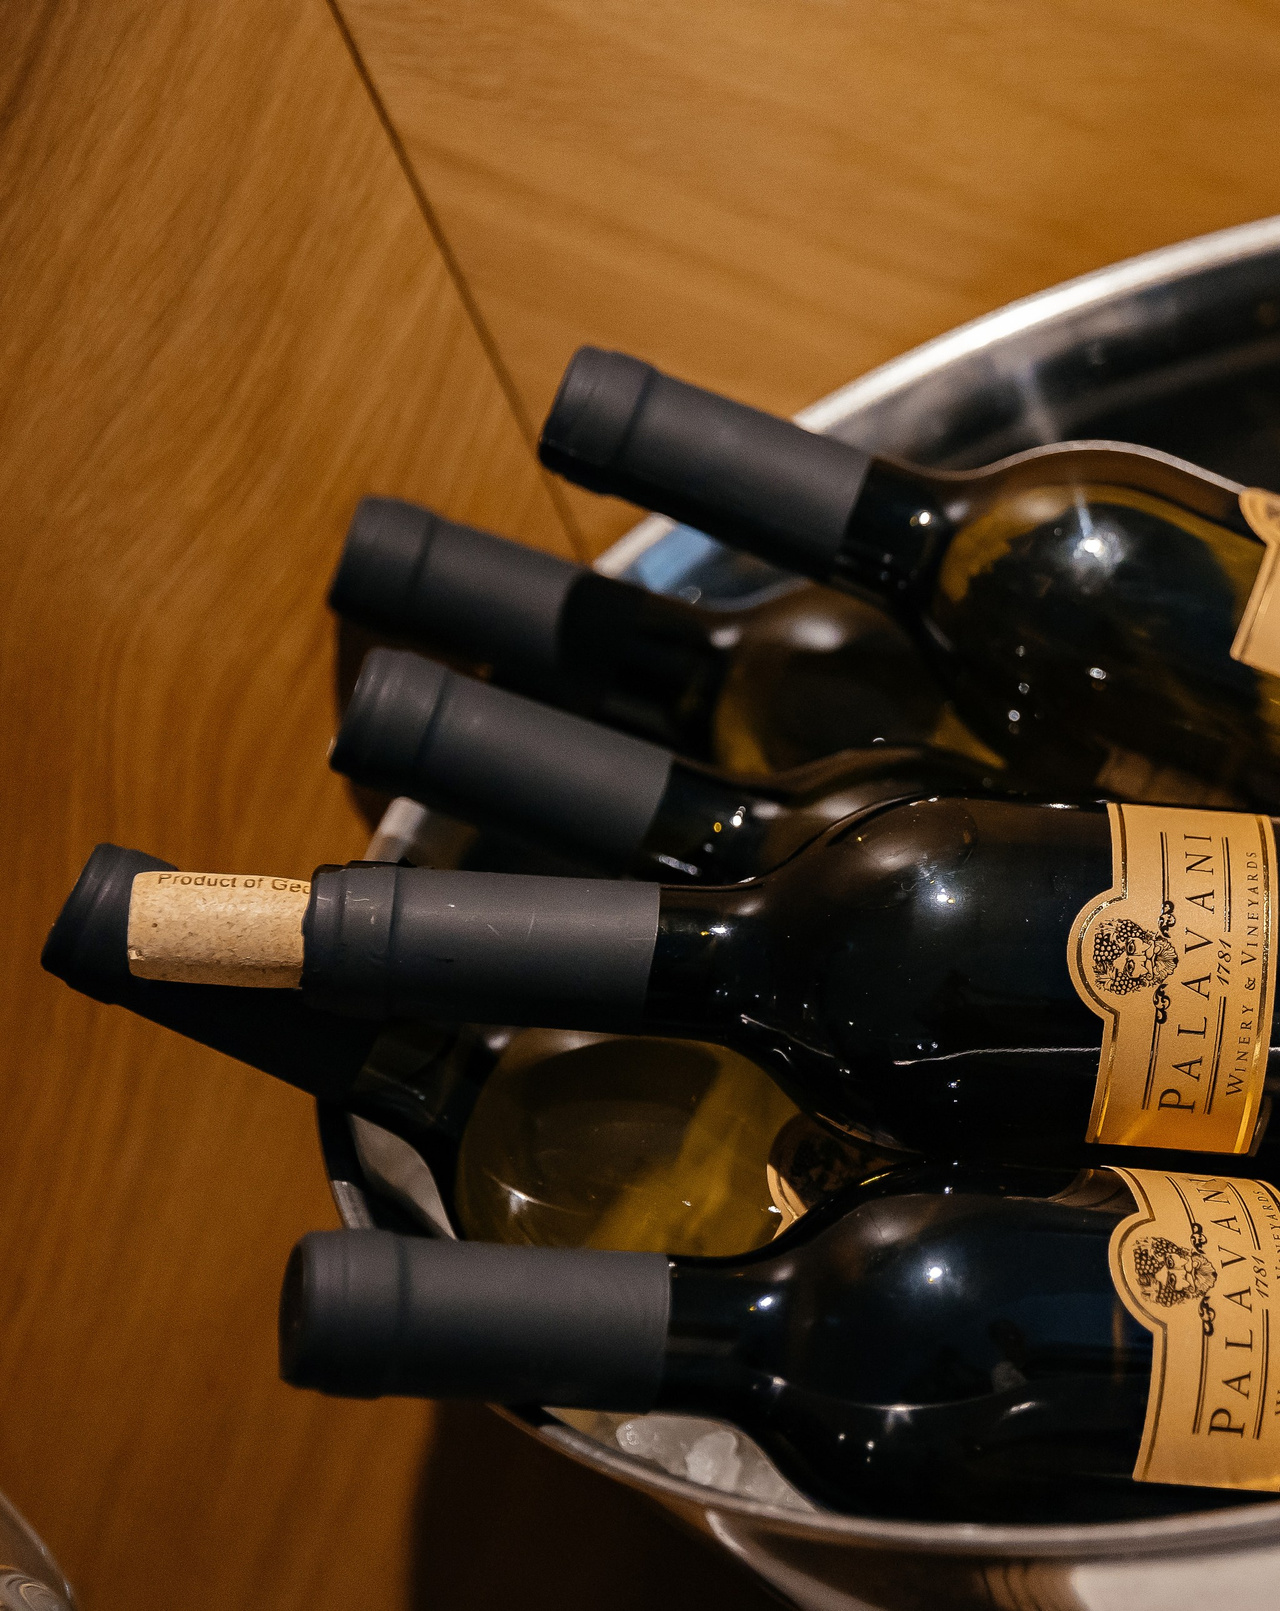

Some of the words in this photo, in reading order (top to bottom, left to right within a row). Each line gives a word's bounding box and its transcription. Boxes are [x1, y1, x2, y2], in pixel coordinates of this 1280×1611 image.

[157, 873, 237, 889] Product
[243, 876, 264, 889] of
[1157, 832, 1215, 1115] PALAVANI
[1216, 937, 1233, 988] 1781
[1244, 976, 1257, 991] &
[1252, 1254, 1270, 1299] 1781
[1187, 1177, 1255, 1440] PALAVANI
